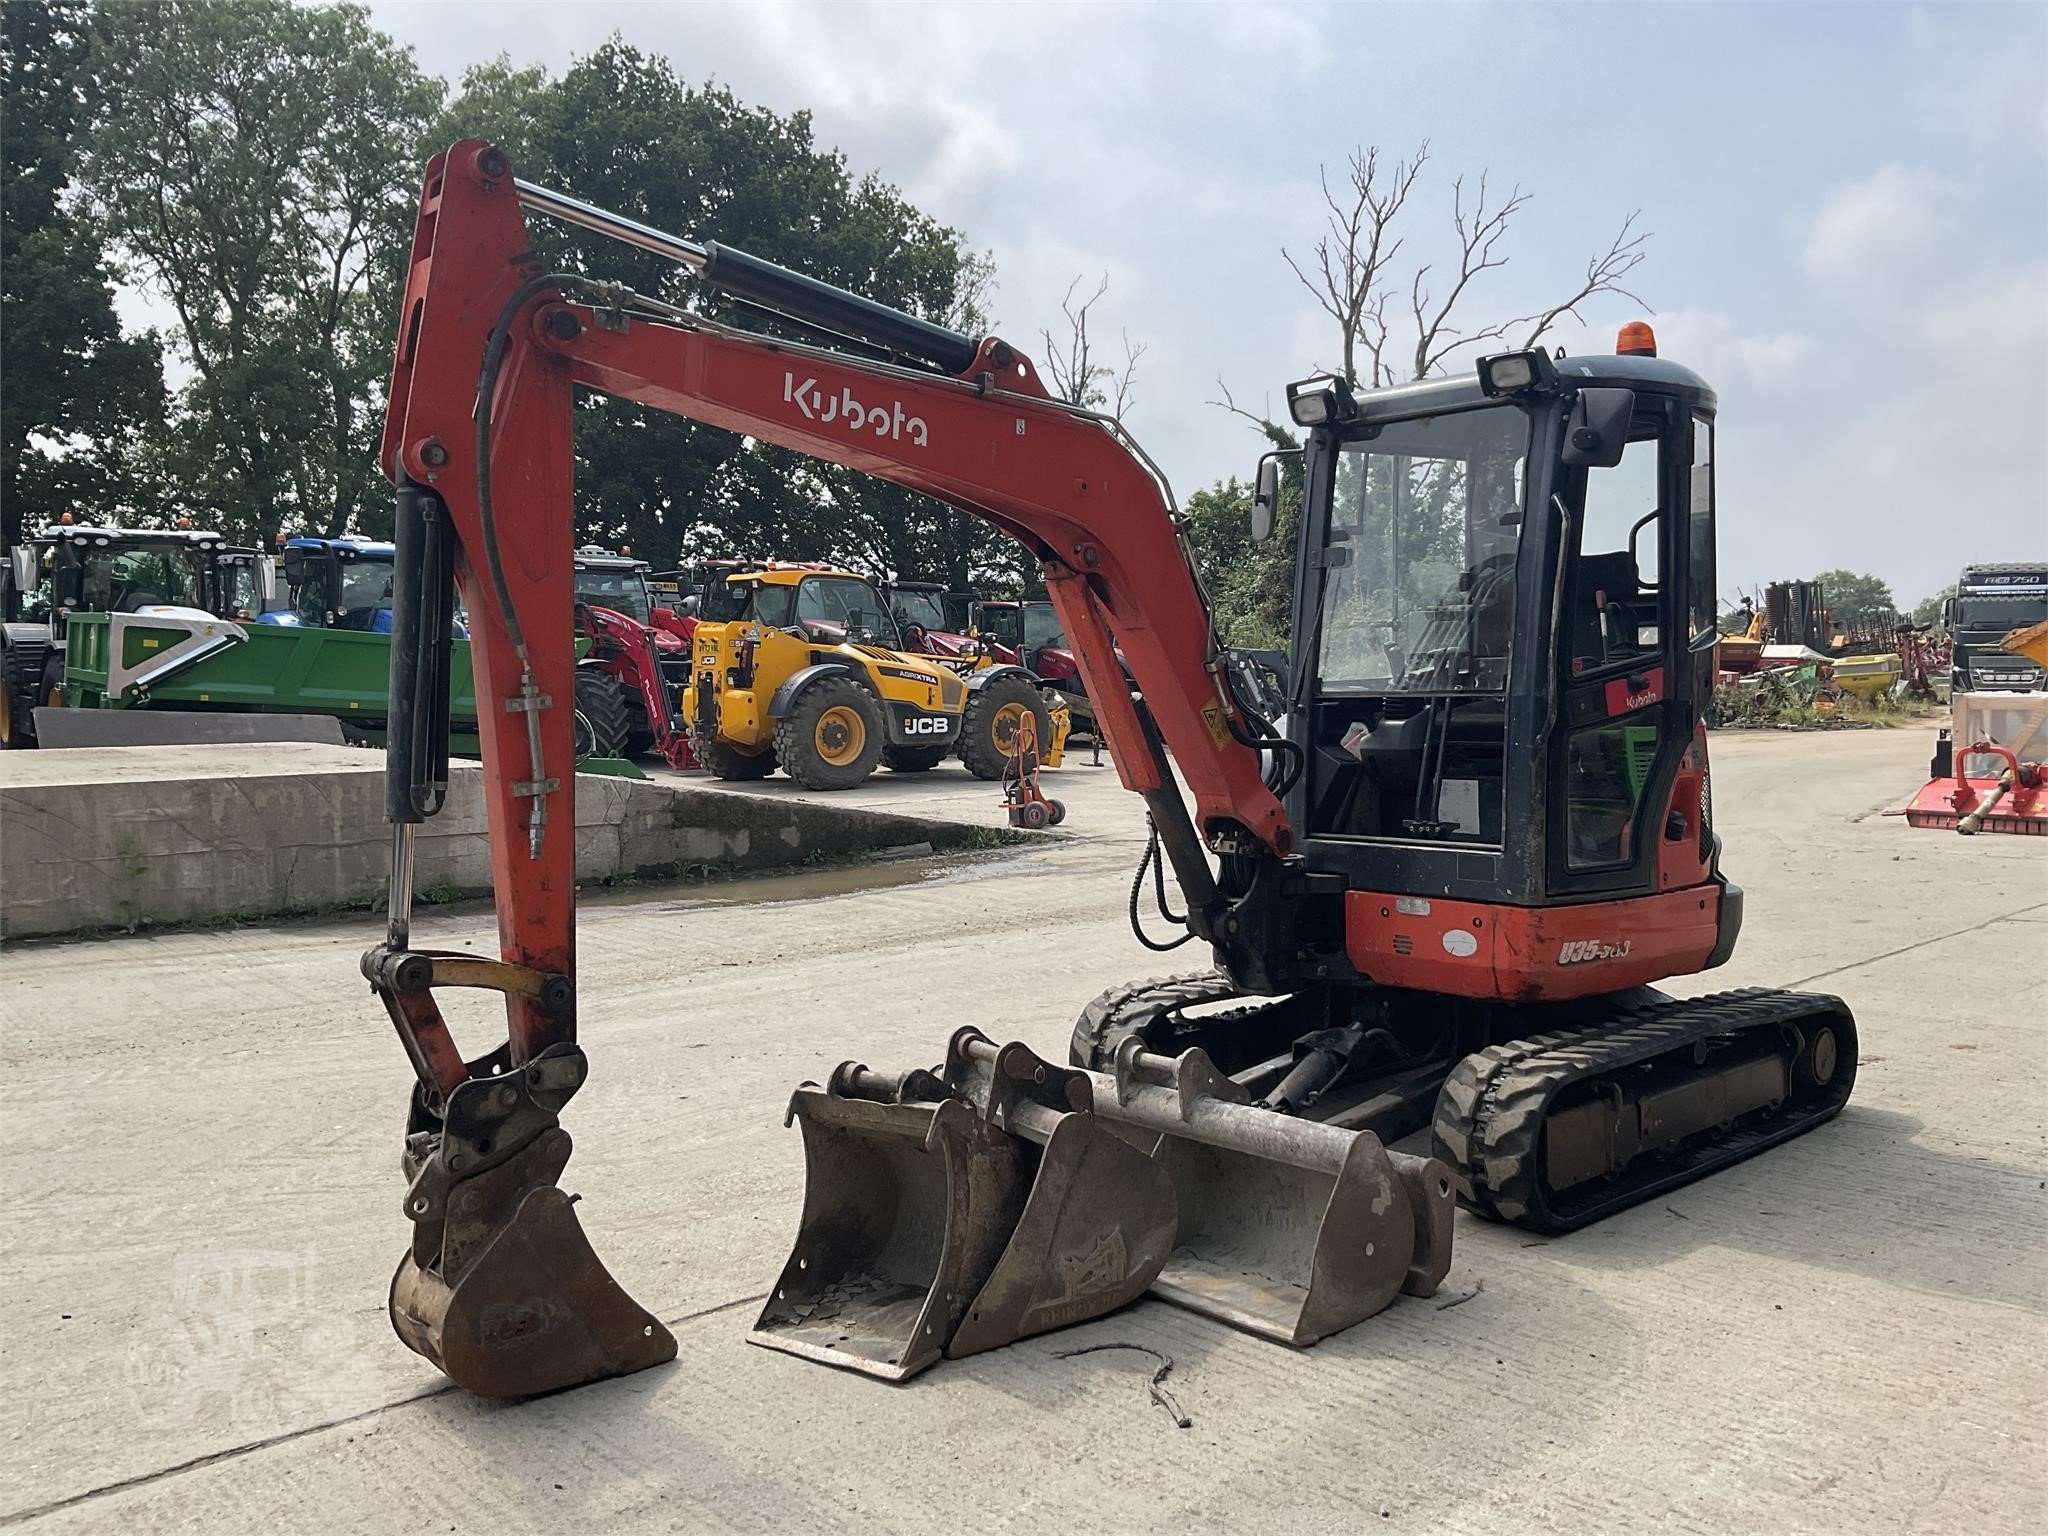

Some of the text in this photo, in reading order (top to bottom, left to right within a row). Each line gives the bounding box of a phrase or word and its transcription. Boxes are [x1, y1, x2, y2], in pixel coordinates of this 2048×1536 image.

[783, 371, 928, 447] Kubota
[2011, 576, 2040, 584] 750
[1626, 691, 1656, 708] Kubota
[904, 717, 949, 735] JCB
